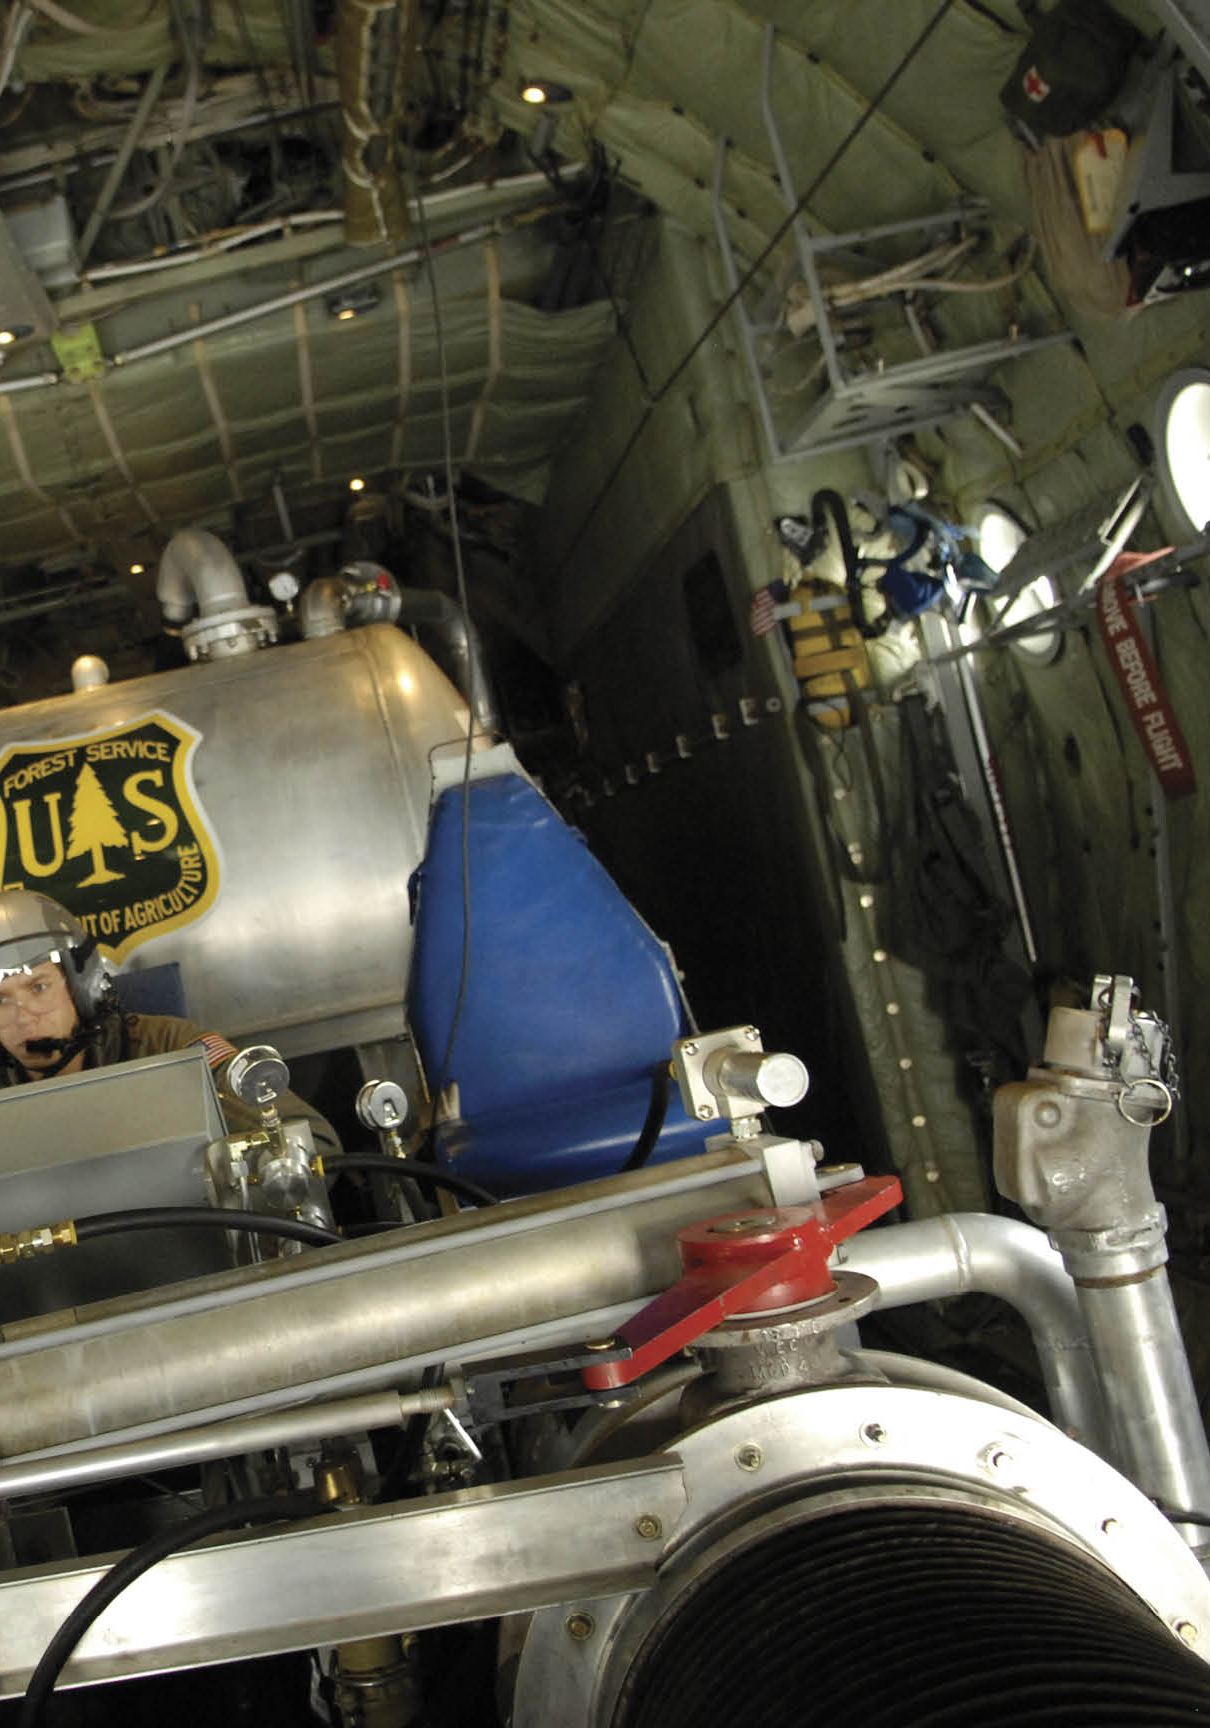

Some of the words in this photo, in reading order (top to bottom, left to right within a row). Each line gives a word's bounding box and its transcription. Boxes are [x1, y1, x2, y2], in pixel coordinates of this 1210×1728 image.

[1115, 637, 1158, 709] BEFORE
[1141, 709, 1184, 772] FLIGHT
[3, 750, 78, 798] FOREST
[84, 740, 172, 763] SERVICE
[13, 793, 64, 878] U
[122, 769, 179, 854] S
[102, 912, 122, 935] OF
[125, 842, 203, 931] AGRICULTURE
